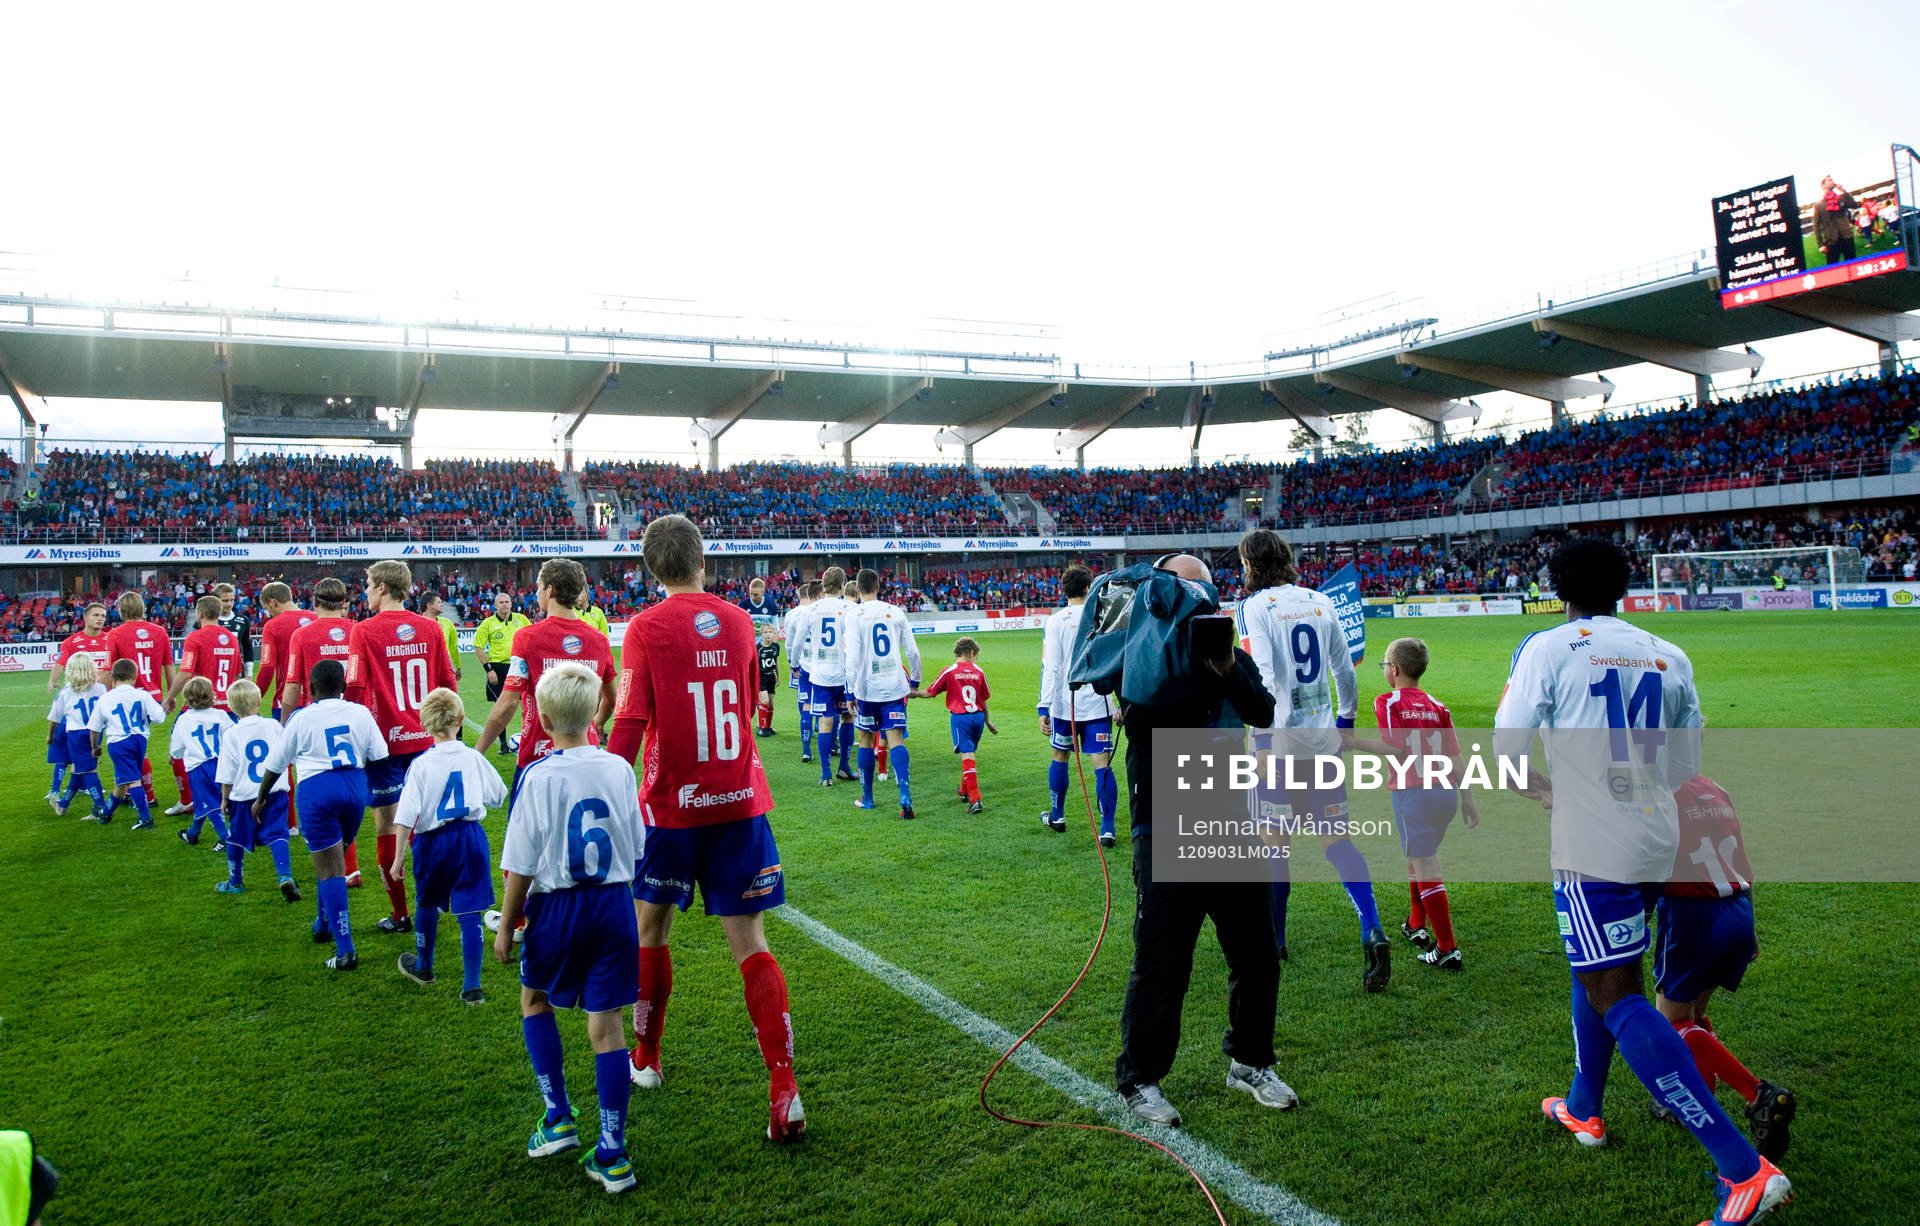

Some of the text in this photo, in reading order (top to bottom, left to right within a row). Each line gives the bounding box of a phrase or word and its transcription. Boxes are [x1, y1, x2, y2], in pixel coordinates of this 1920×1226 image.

[49, 548, 121, 560] Myresjöhus
[183, 547, 249, 559] Myresjöhus
[307, 545, 369, 558] Myresjöhus
[422, 545, 480, 555] Myresjöhus
[530, 543, 584, 554] Myresjöhus
[725, 542, 773, 552] Myresjöhus
[814, 542, 860, 551] Myresjöhus
[898, 541, 941, 550] Myresjöhus
[1330, 593, 1348, 606] ELA
[1524, 600, 1564, 615] TRAILER
[1336, 601, 1362, 618] RIGES
[993, 619, 1024, 630] burde
[1339, 612, 1365, 630] BOLLS
[821, 617, 836, 647] 5
[872, 622, 891, 657] 6
[1344, 626, 1363, 641] UBB
[320, 643, 349, 655] SÖDERBE
[386, 642, 428, 658] BERGHOLTZ
[1291, 623, 1321, 684] 9
[1569, 639, 1591, 651] pwc
[696, 650, 728, 667] LANTZ
[1589, 655, 1655, 668] Swedbank
[137, 652, 153, 683] 4
[216, 659, 229, 692] 5
[388, 658, 428, 712] 10
[961, 685, 978, 713] 9
[112, 701, 145, 735] 14
[687, 678, 741, 762] 16
[1589, 668, 1667, 764] 14
[191, 723, 220, 758] 11
[325, 725, 357, 769] 5
[245, 739, 269, 783] 8
[436, 770, 470, 821] 4
[683, 785, 755, 810] Fellessons
[567, 797, 612, 883] 6
